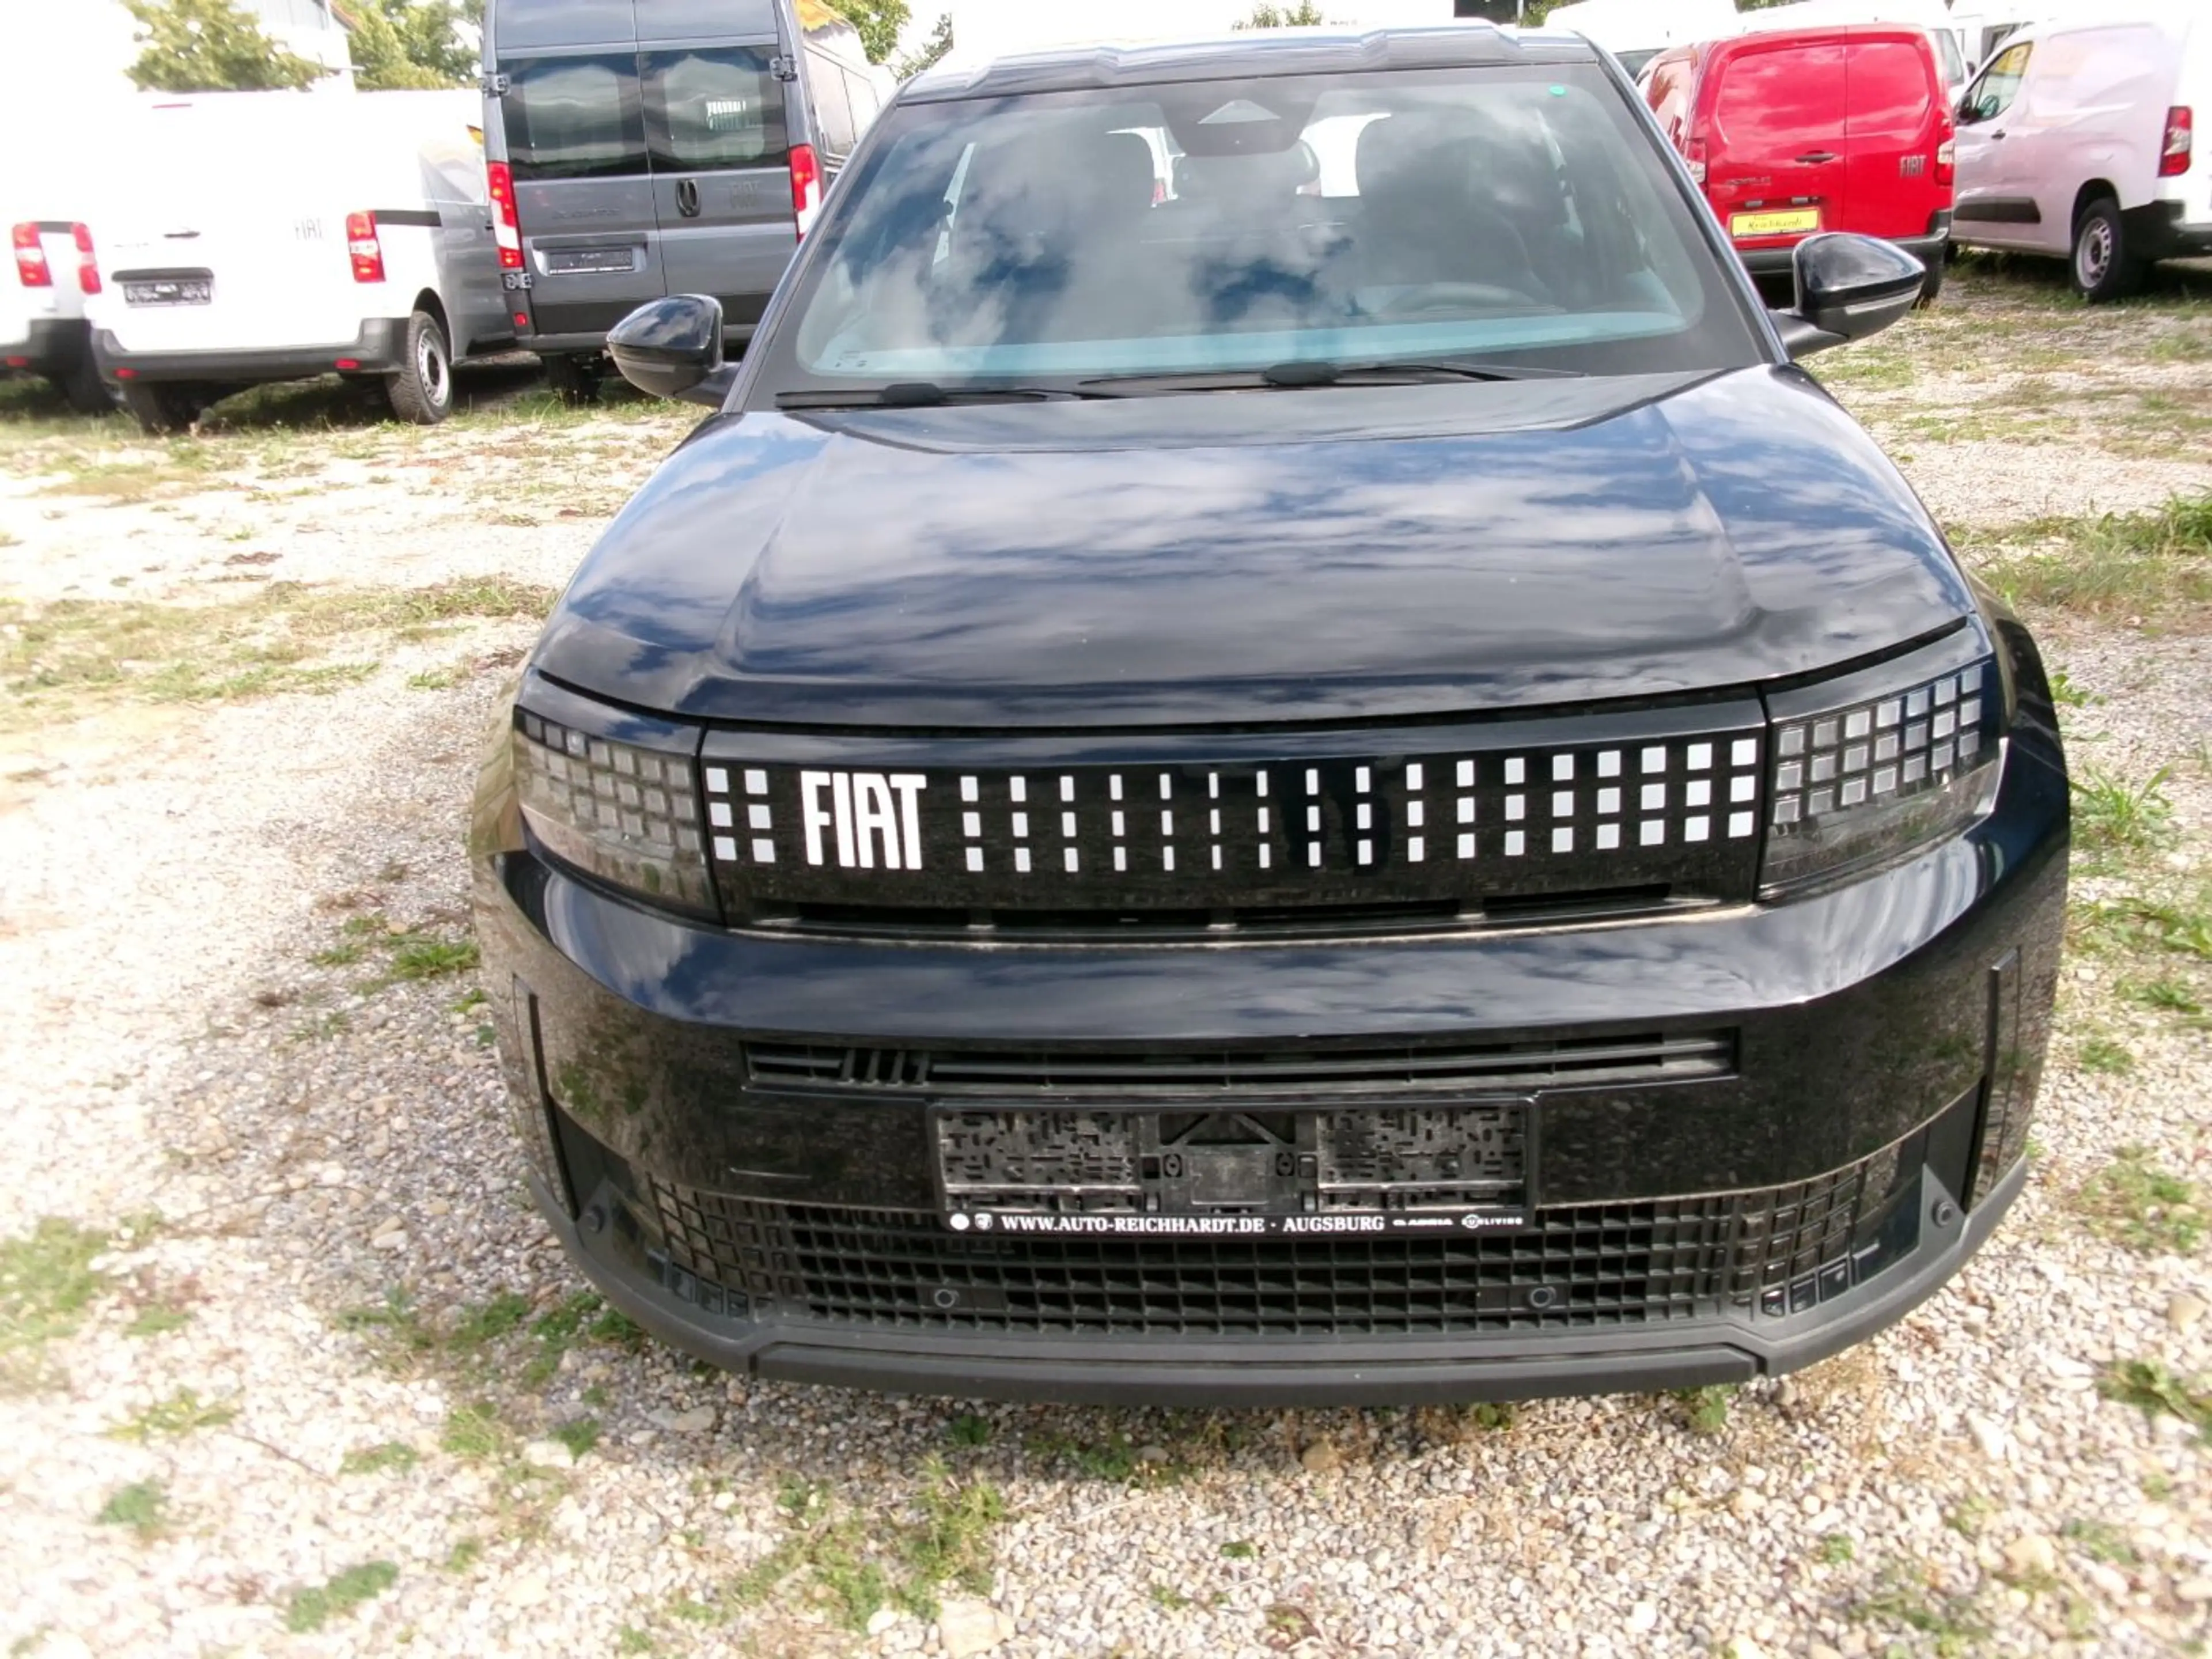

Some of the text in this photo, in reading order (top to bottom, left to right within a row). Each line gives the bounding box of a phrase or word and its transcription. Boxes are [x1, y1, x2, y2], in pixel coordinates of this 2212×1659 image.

[1899, 154, 1927, 177] FIAT
[801, 771, 927, 870] FIAT
[1001, 1215, 1265, 1233] WWW.AUTO-REICHHARDT.DE
[1282, 1216, 1385, 1232] AUGSBURG
